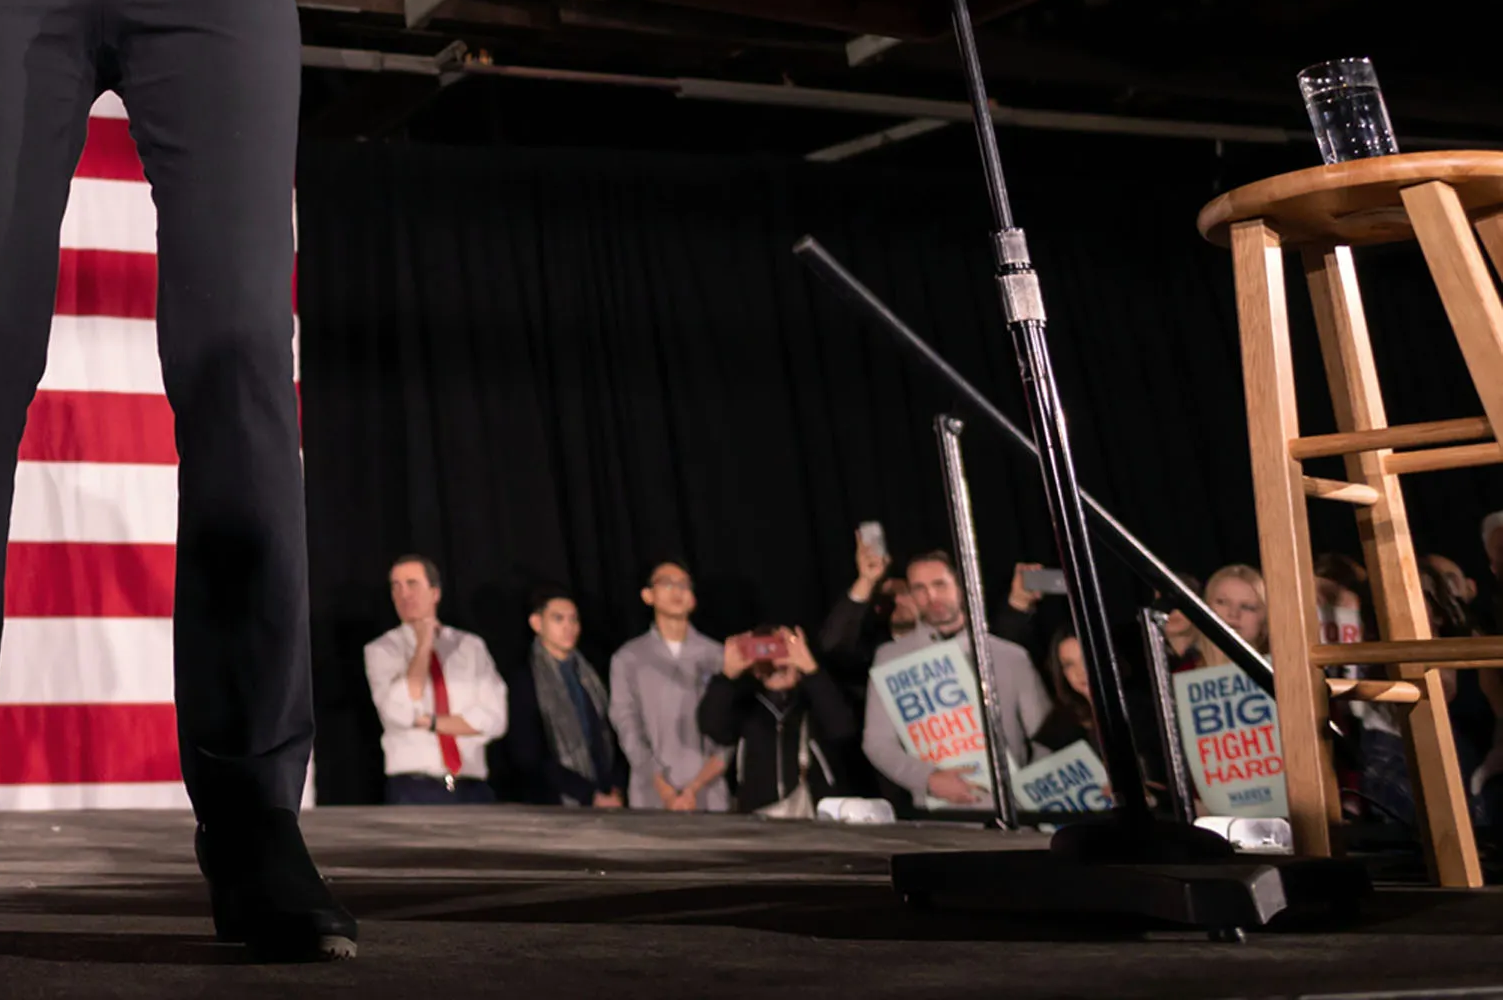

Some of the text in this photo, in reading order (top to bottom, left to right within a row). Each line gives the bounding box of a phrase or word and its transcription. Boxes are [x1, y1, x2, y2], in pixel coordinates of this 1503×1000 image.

[885, 654, 956, 696] DREAM
[895, 677, 970, 723] BIG
[1192, 693, 1273, 735] BIG
[907, 704, 978, 752] FIGHT
[1196, 723, 1275, 766] FIGHT
[1022, 758, 1094, 804] DREAM
[1203, 755, 1285, 788] HARD
